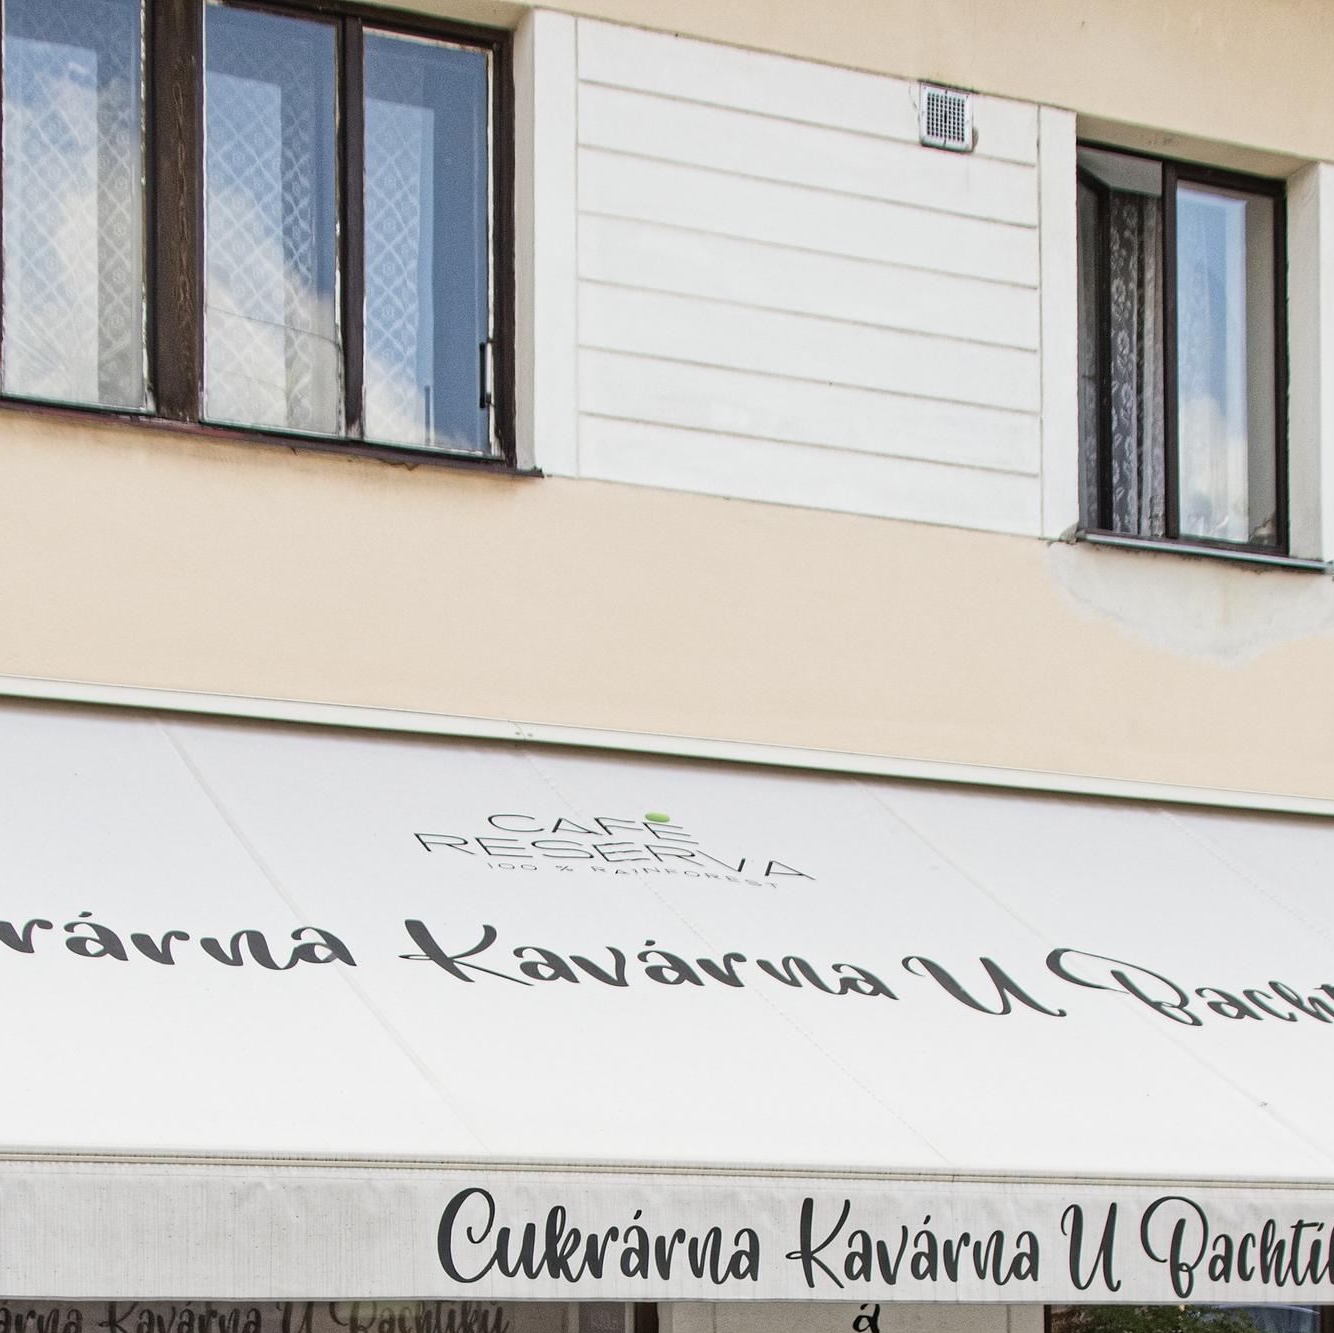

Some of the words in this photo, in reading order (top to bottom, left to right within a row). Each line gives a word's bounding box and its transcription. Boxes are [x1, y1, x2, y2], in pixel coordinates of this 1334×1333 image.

[486, 813, 699, 844] CAFÉ
[414, 833, 816, 881] RESERVA
[590, 865, 780, 889] RAINFOREST
[398, 919, 900, 1001] Kavárna
[902, 954, 1067, 1017] U
[438, 1187, 760, 1286] Cukrárna
[786, 1196, 1040, 1290] Kavárna
[1060, 1203, 1122, 1293] U
